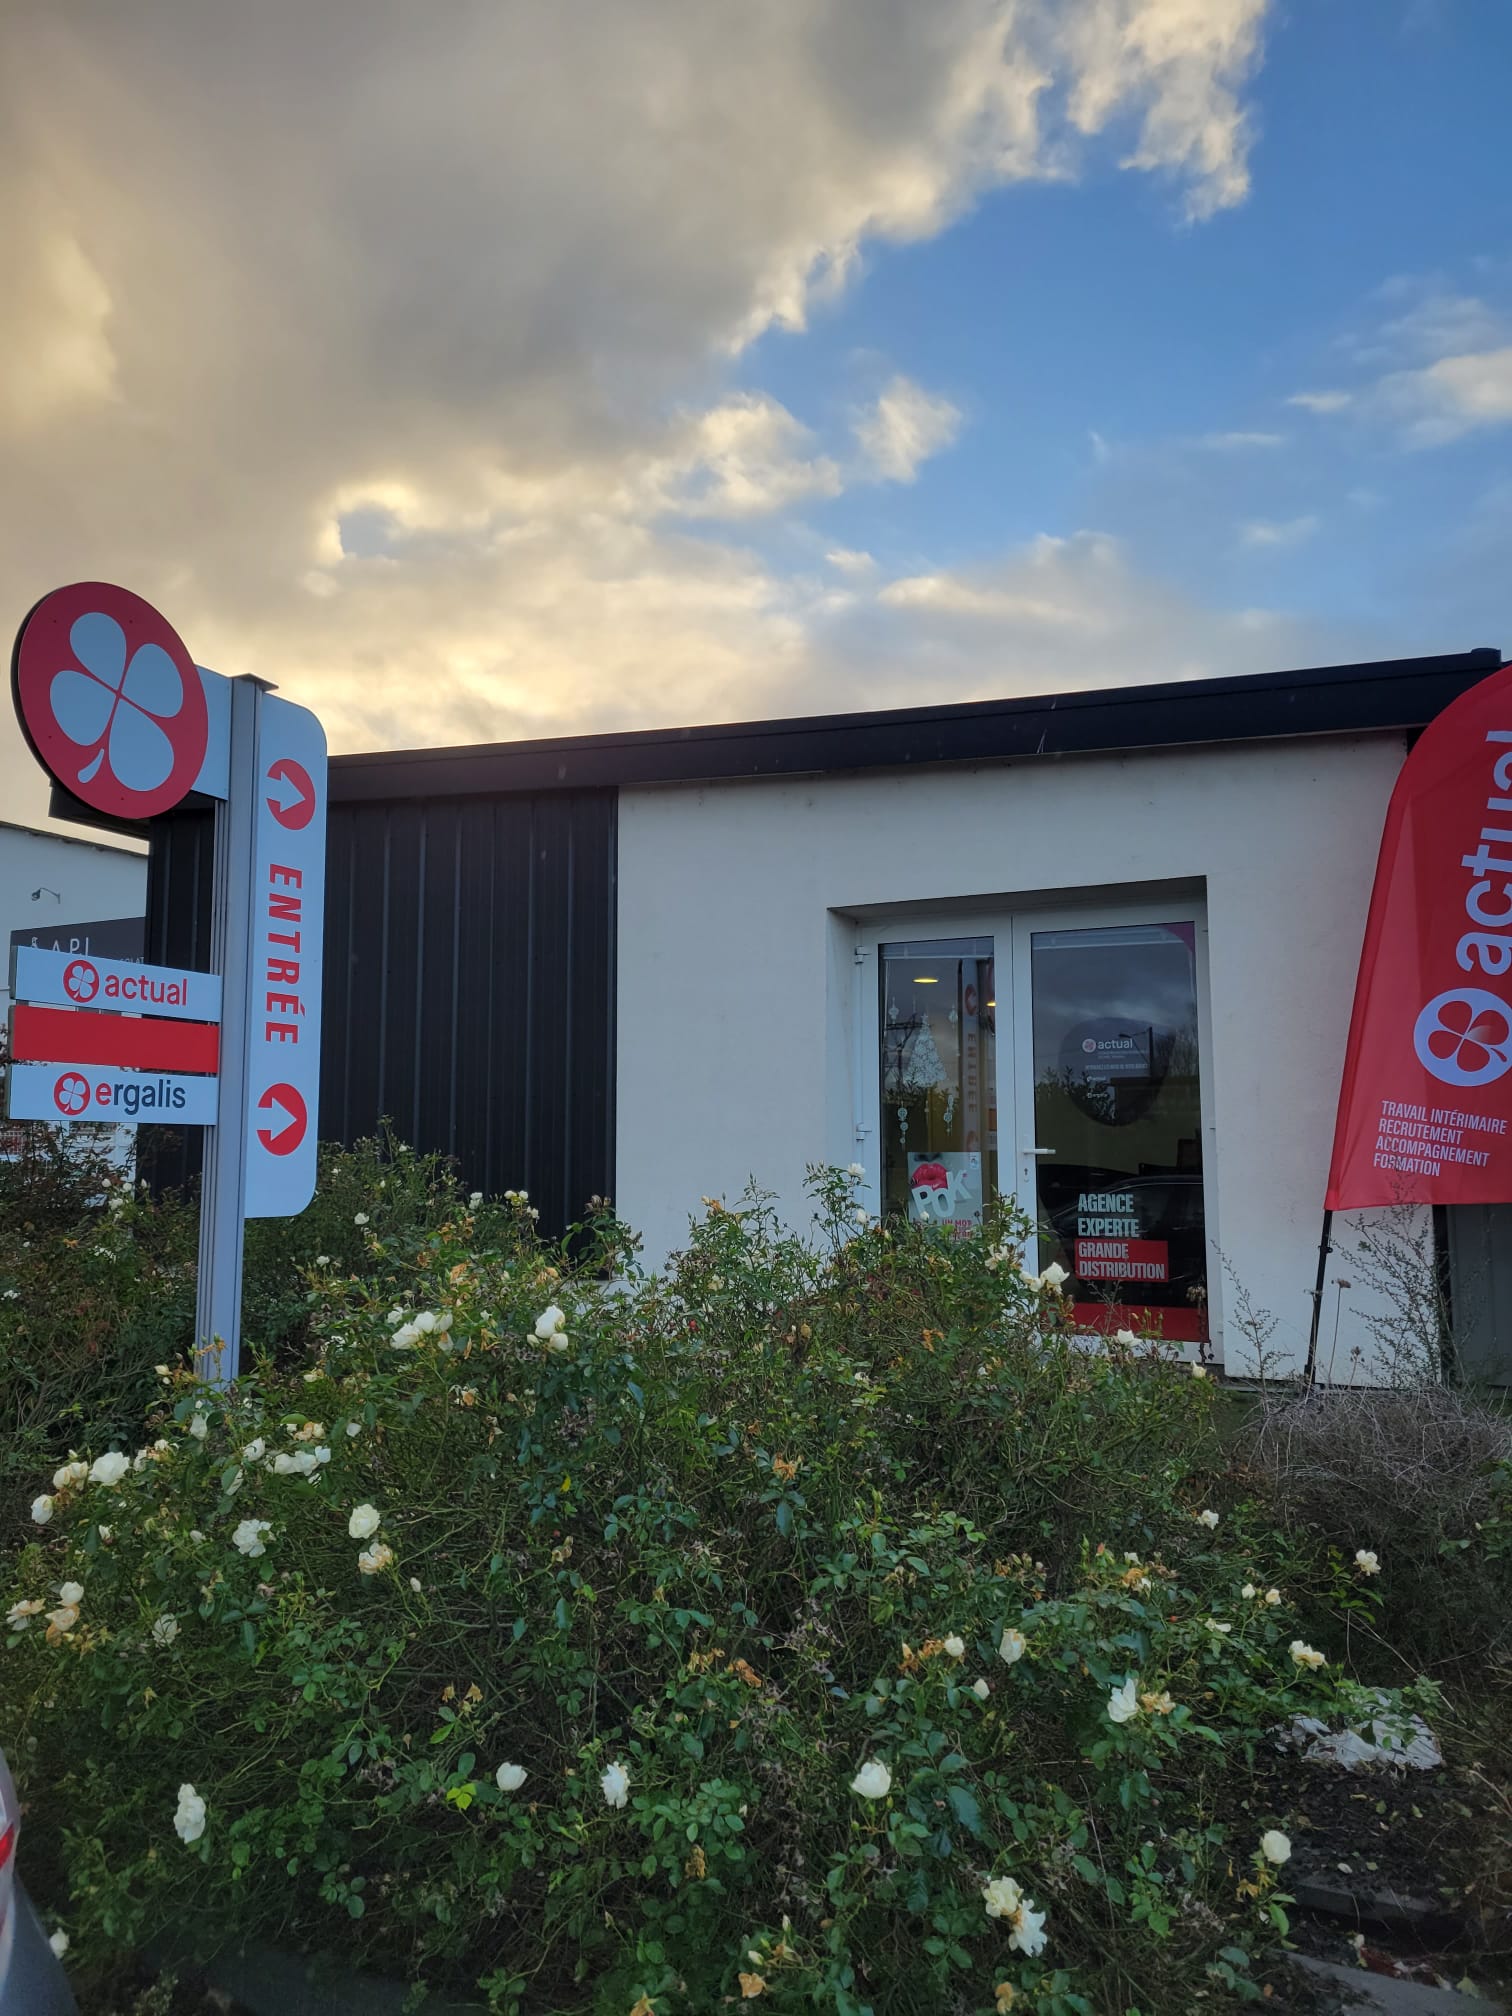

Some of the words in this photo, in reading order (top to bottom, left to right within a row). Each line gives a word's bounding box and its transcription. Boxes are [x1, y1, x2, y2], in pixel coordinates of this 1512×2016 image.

[265, 863, 306, 1044] ENTRÉE
[104, 975, 188, 1006] actual
[1097, 1039, 1133, 1050] actual
[95, 1078, 186, 1116] ergalis
[1381, 1100, 1428, 1122] TRAVAIL
[1430, 1108, 1508, 1135] INTÉRIMAIRE
[1378, 1118, 1464, 1145] RECRUTEMENT
[1373, 1152, 1441, 1177] FORMATION
[1375, 1135, 1490, 1168] ACCOMPAGNEMENT
[1077, 1193, 1135, 1213] AGENCE
[1077, 1217, 1140, 1238] EXPERTE
[1079, 1241, 1130, 1259] GRANDE
[1079, 1260, 1165, 1280] DISTRIBUTION
